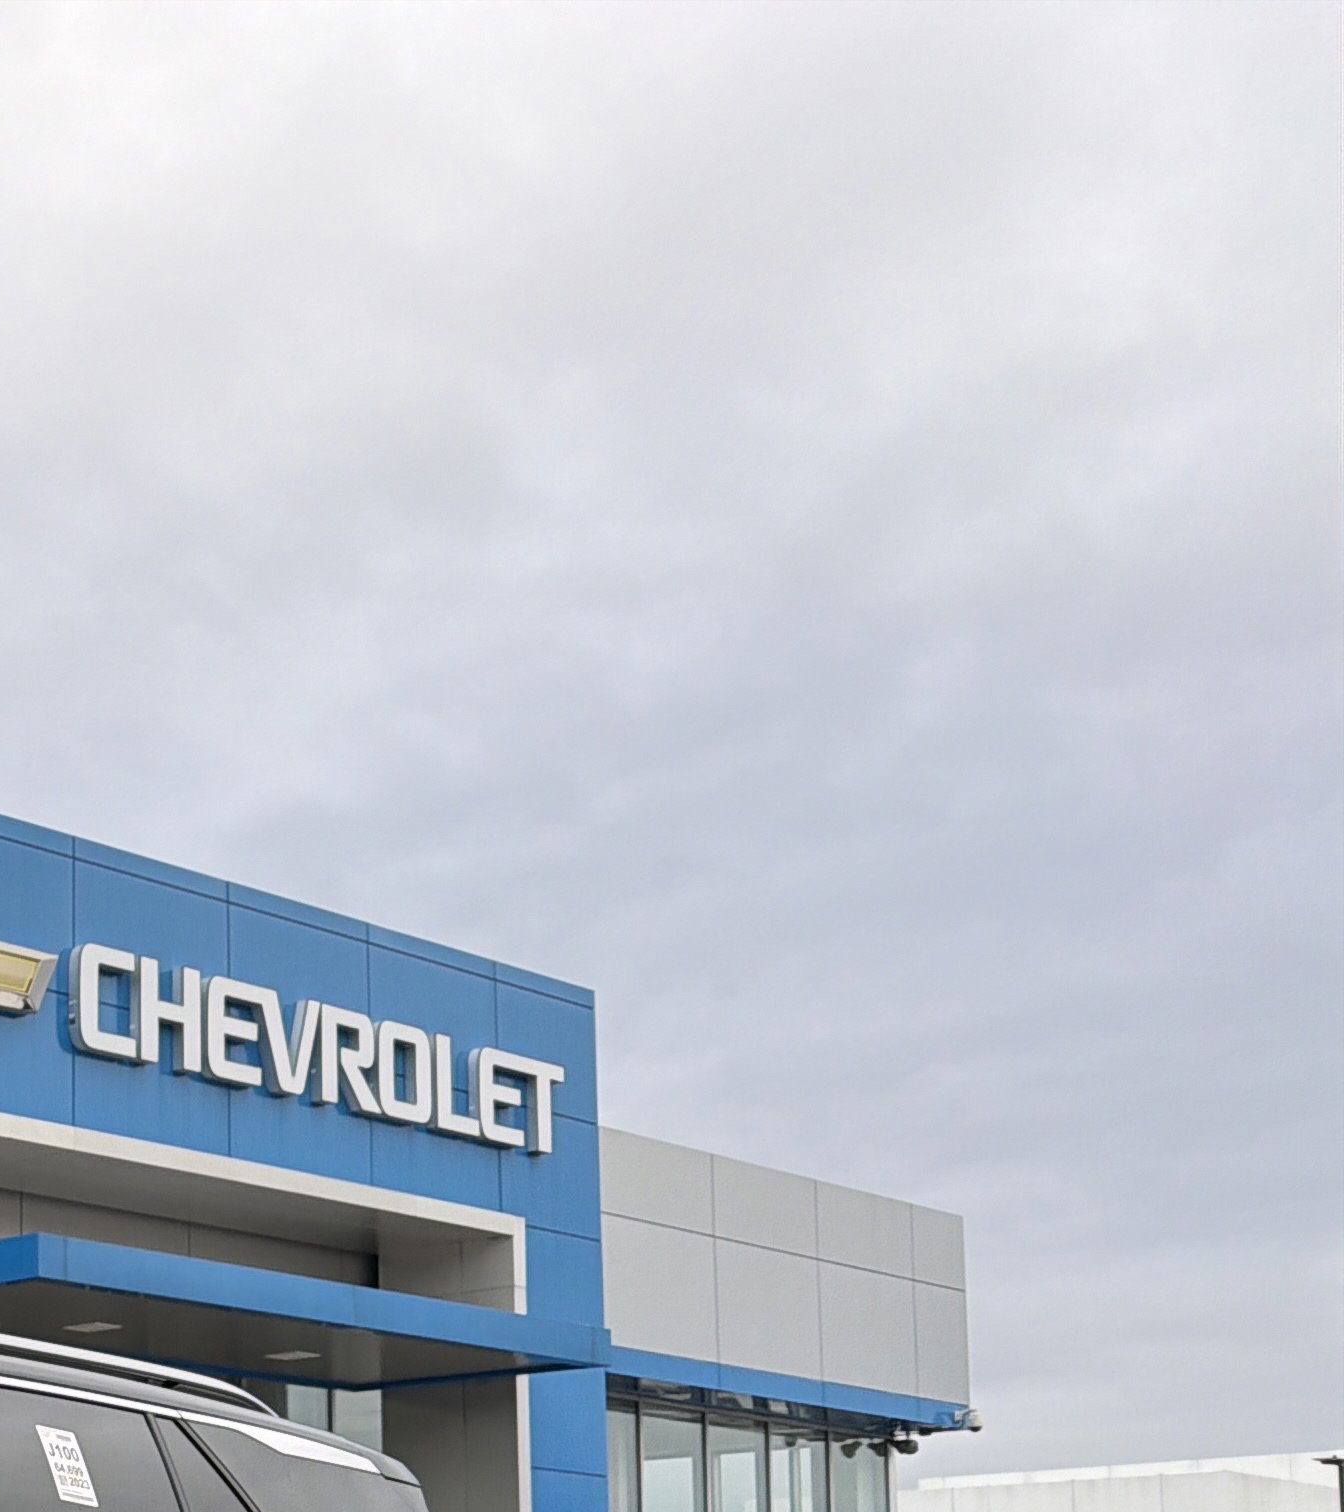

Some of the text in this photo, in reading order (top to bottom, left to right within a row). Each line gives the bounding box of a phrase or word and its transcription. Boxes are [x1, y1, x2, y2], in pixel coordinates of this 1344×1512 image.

[69, 942, 565, 1156] CHEVROLET
[48, 1442, 80, 1463] J100
[68, 1477, 91, 1490] 2023
